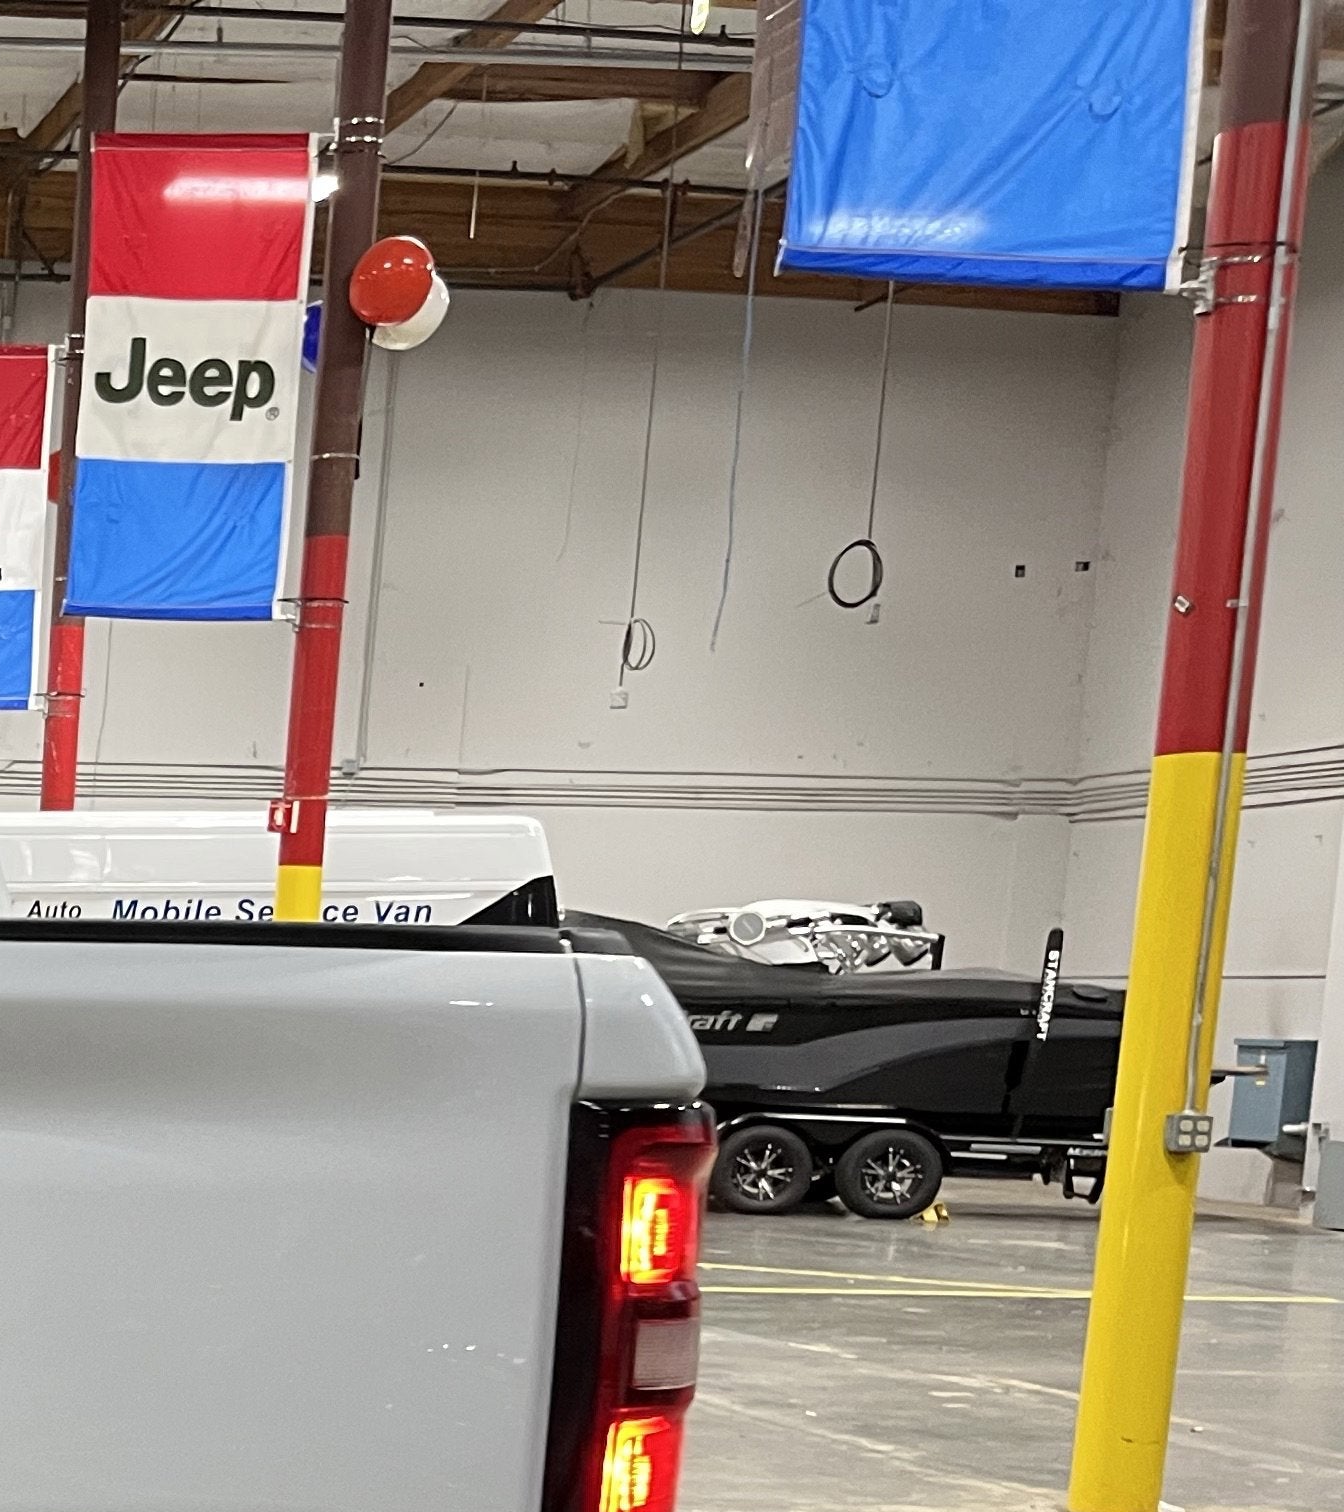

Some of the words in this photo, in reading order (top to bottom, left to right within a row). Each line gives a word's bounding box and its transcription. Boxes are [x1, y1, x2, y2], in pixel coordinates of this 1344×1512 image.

[93, 337, 276, 421] Jeep
[26, 900, 83, 919] Auto
[111, 899, 222, 921] Mobile
[235, 899, 359, 922] Sece
[374, 900, 433, 922] Van
